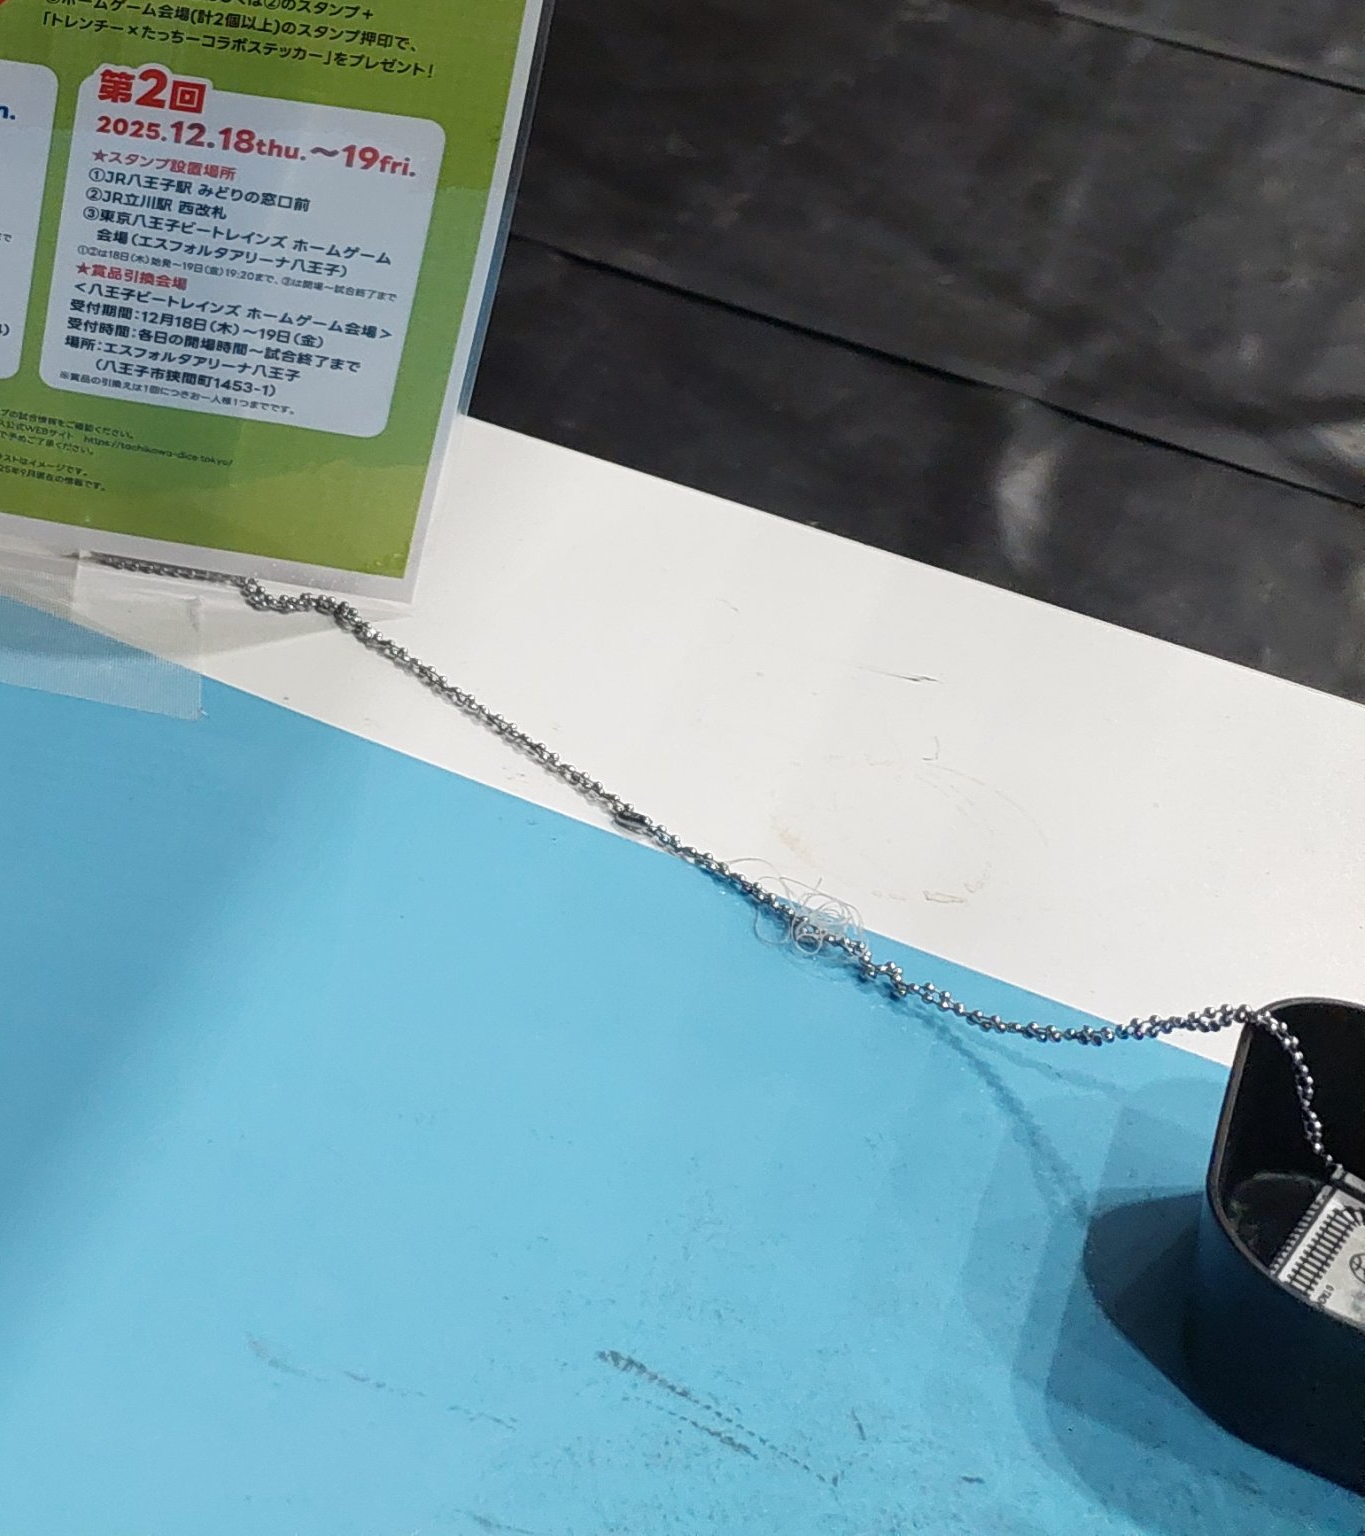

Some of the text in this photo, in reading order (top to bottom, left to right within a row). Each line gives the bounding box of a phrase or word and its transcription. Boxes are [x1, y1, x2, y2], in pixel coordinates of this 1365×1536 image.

[97, 67, 208, 114] 第2回
[177, 200, 228, 221] 西改札
[197, 183, 312, 214] みどりの窓口前
[291, 238, 393, 266] ホームゲーム
